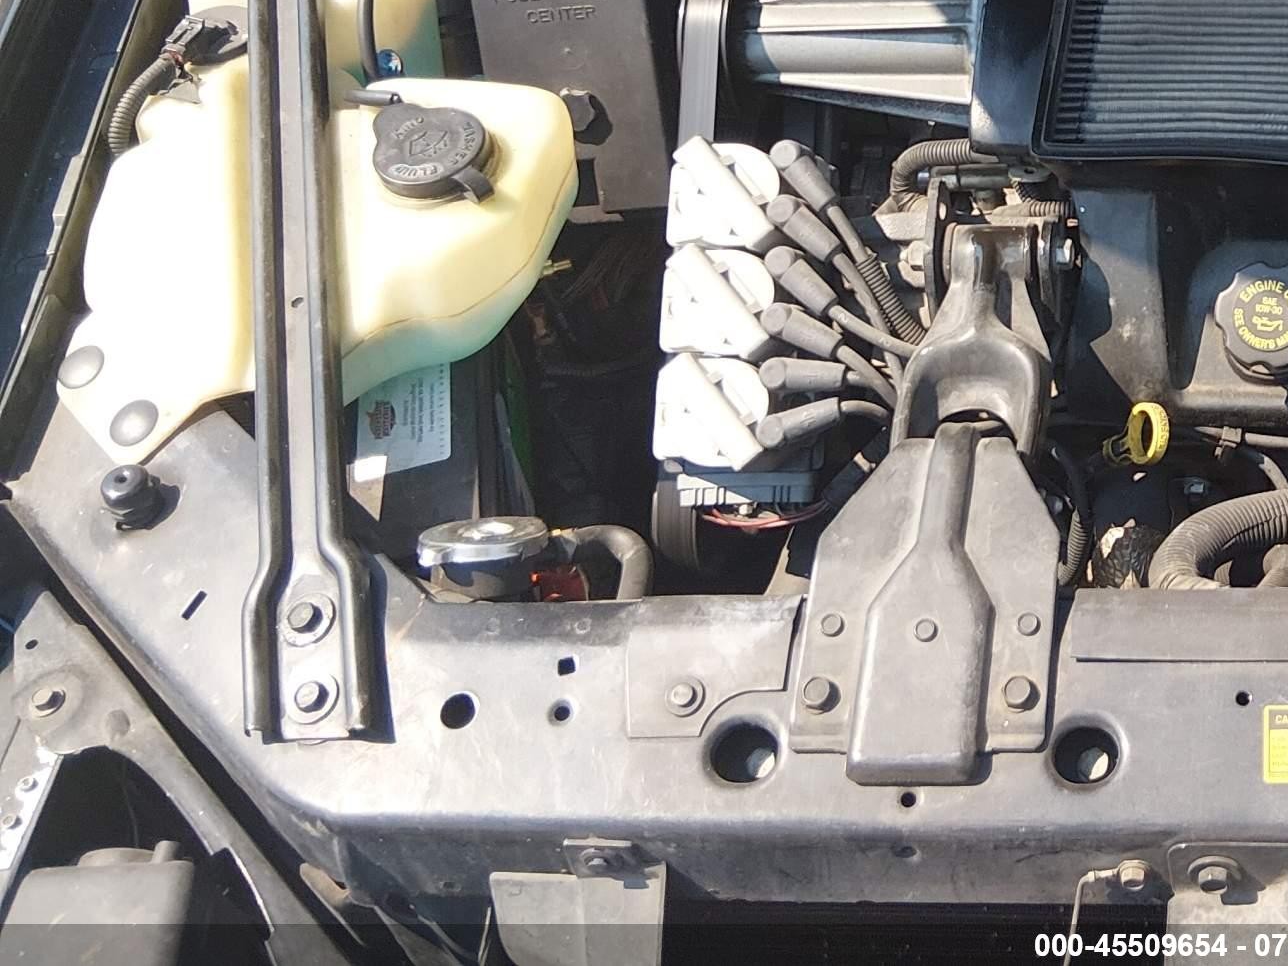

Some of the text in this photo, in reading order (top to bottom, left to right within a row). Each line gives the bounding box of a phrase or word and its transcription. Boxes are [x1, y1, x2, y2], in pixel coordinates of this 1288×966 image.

[527, 4, 596, 24] CENTER
[1239, 279, 1286, 303] ENGINE
[1262, 296, 1278, 305] SAE
[1233, 307, 1245, 327] SEE
[1238, 326, 1276, 349] OWNER'S
